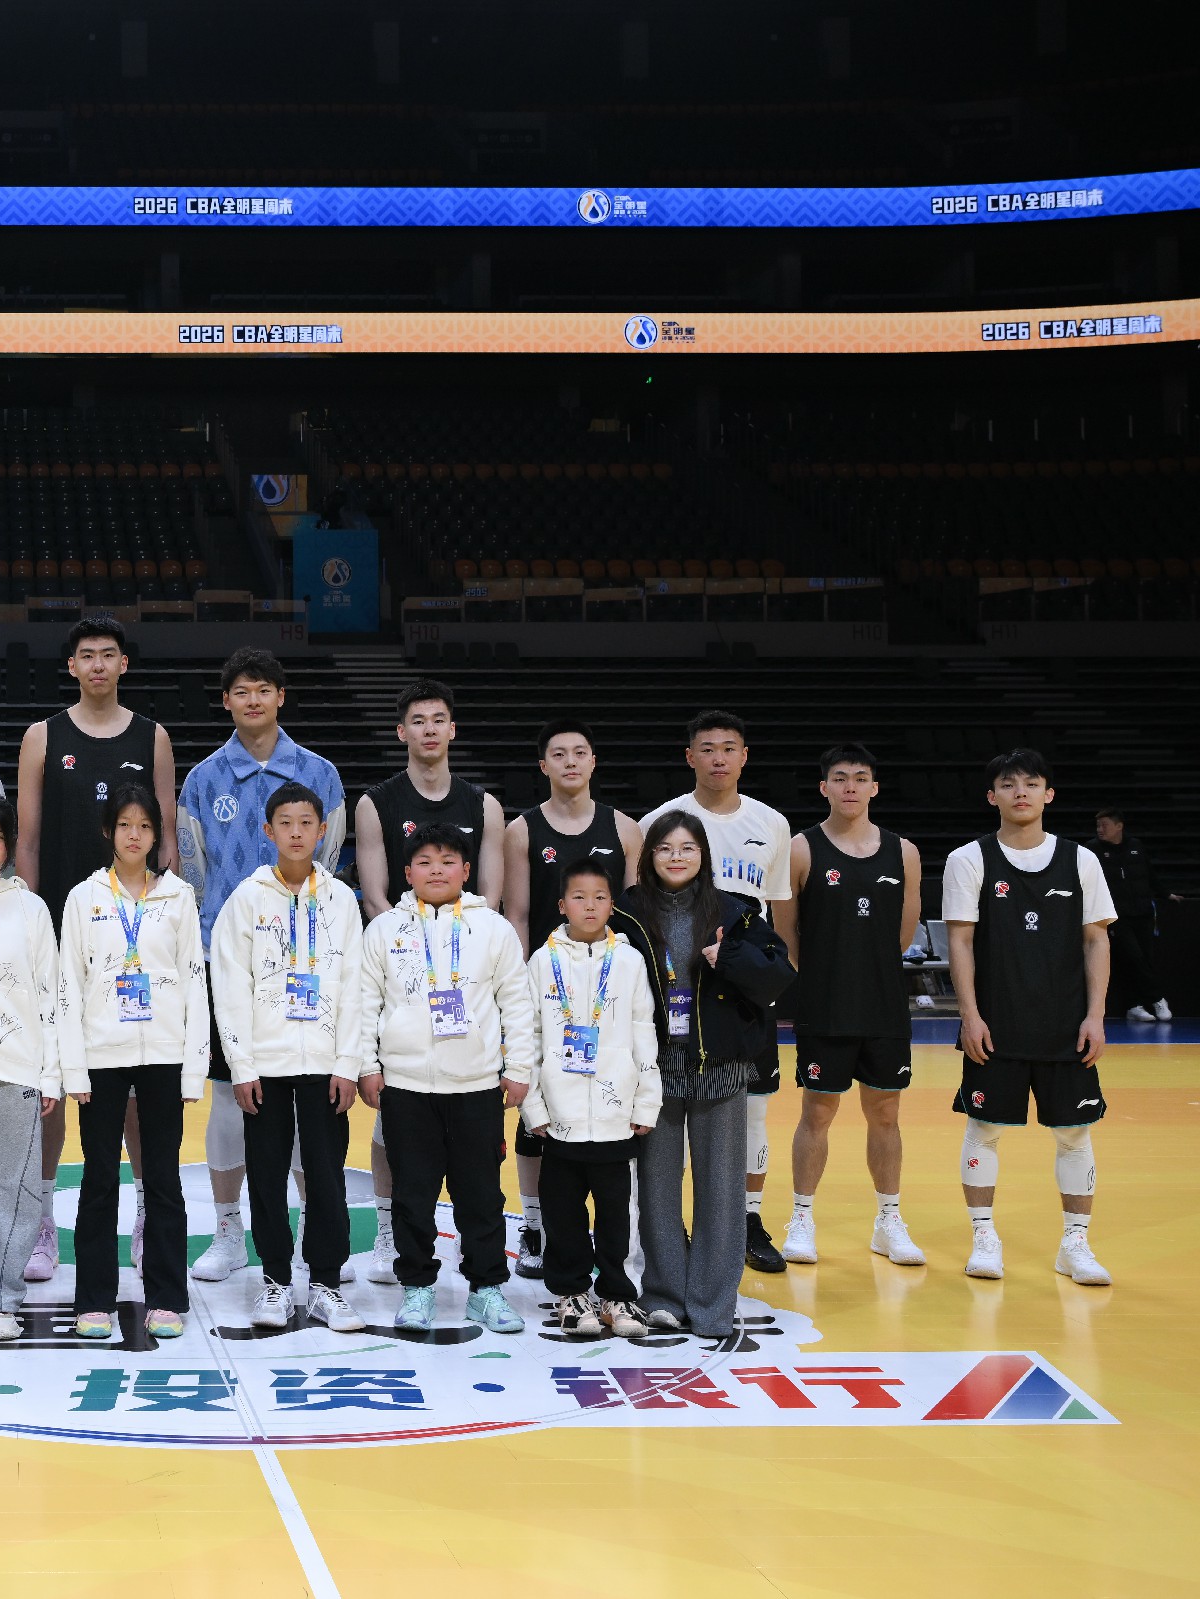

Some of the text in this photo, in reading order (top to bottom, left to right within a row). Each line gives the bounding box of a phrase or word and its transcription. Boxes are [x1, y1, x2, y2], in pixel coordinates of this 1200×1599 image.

[134, 197, 293, 215] 2026 CBA全明星周末
[932, 189, 1103, 214] 2026 CBA全明星周末
[179, 325, 342, 343] 2026 CBA全明星周末
[662, 327, 695, 335] 全明星
[982, 315, 1162, 341] 2026 CBA全明星周末
[280, 624, 304, 640] H9
[410, 625, 440, 641] H10
[853, 624, 882, 640] H10
[991, 624, 1018, 640] H11
[139, 989, 151, 1007] C
[306, 989, 319, 1007] C
[584, 1042, 597, 1061] C
